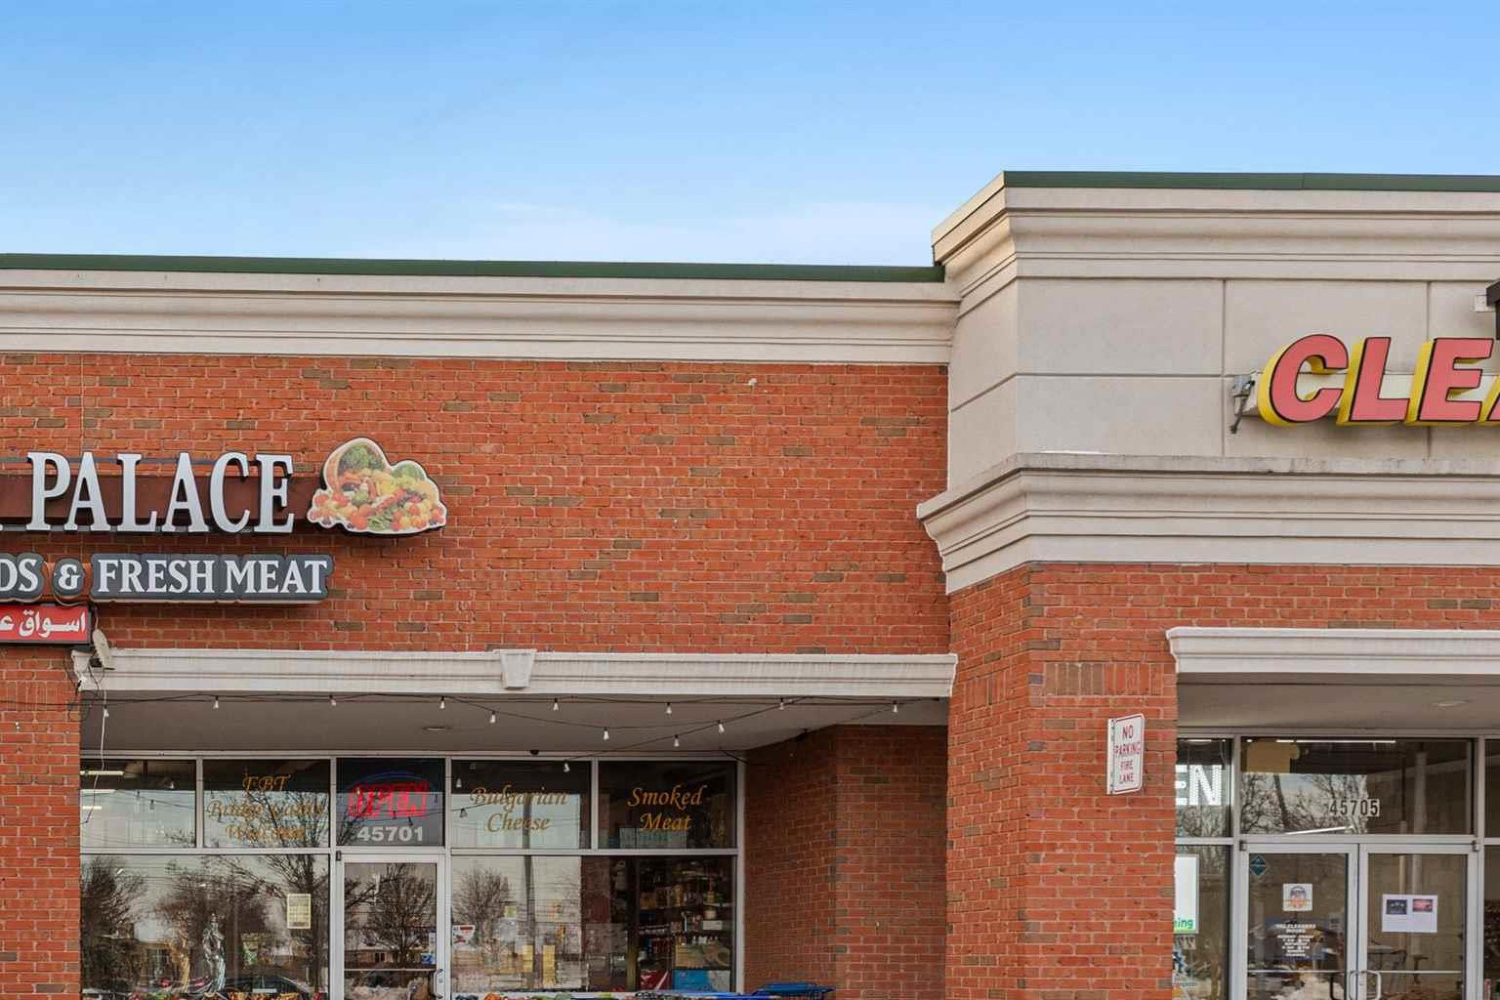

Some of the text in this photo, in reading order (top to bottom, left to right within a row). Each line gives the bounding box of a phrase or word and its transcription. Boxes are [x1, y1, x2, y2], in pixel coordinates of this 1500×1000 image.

[1260, 334, 1500, 425] CLE
[25, 451, 295, 533] PALACE
[57, 563, 82, 591] &
[97, 558, 214, 593] FRESH
[225, 559, 328, 594] MEAT
[18, 609, 86, 638] اسواق
[1122, 725, 1134, 739] NO
[1115, 741, 1141, 755] PARKING
[1120, 760, 1133, 772] FIRE
[1120, 773, 1134, 785] LANE
[1175, 764, 1222, 806] EN
[470, 784, 569, 812] Bulgarian
[627, 784, 708, 811] Smoked
[1329, 799, 1379, 816] 45705
[486, 812, 550, 833] Cheese
[640, 812, 692, 833] Meat
[356, 825, 423, 843] 45701
